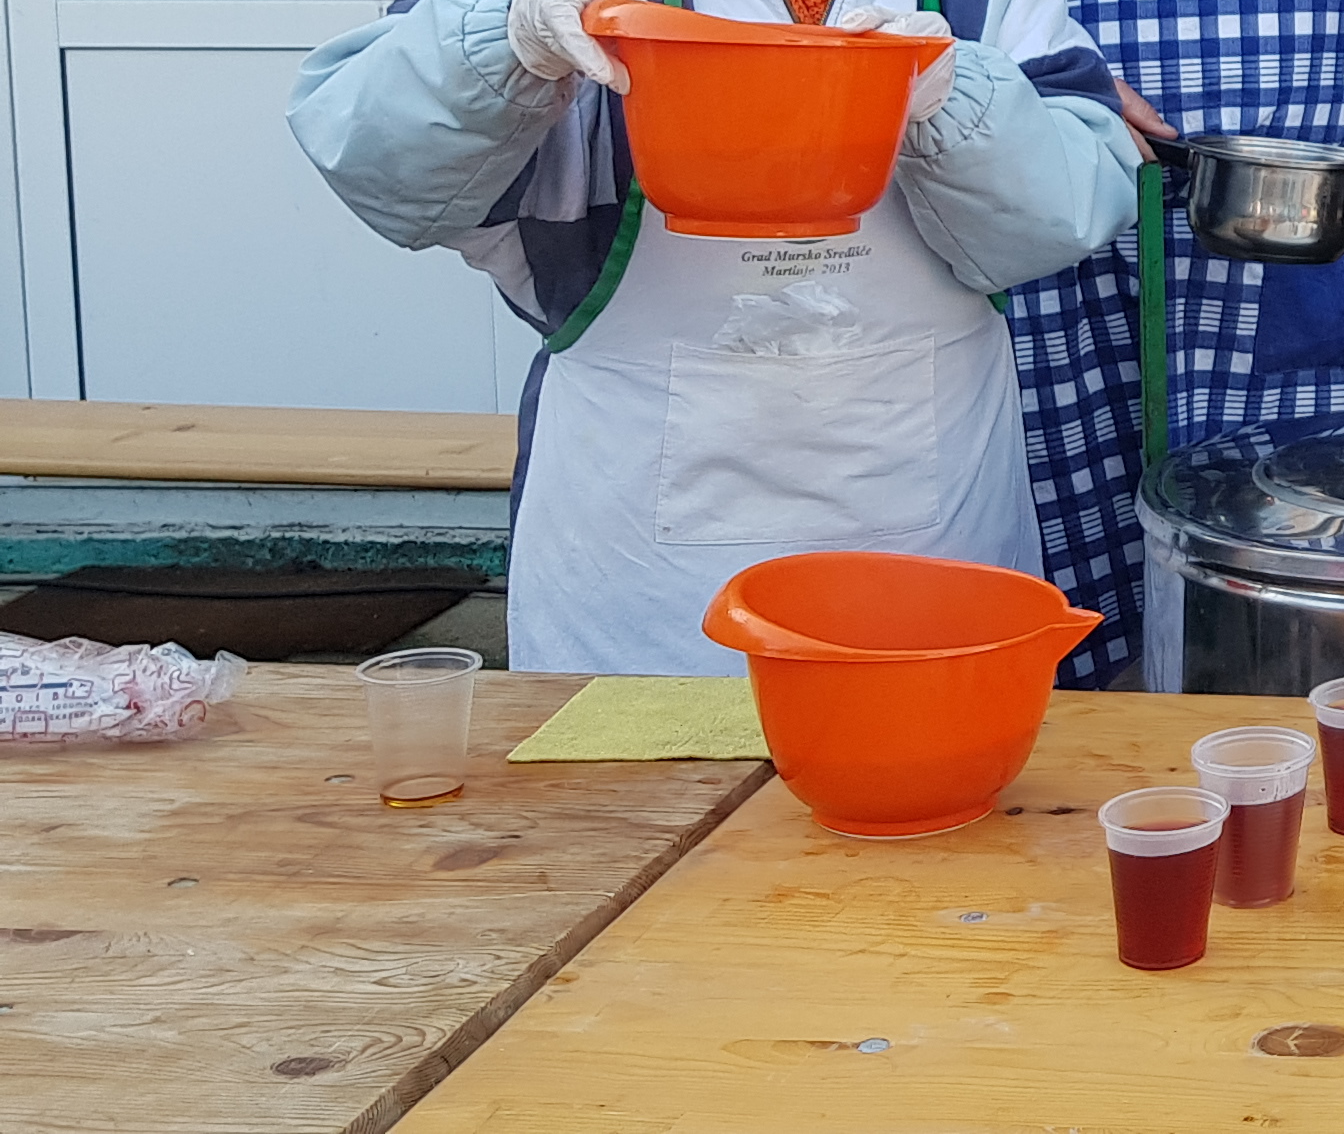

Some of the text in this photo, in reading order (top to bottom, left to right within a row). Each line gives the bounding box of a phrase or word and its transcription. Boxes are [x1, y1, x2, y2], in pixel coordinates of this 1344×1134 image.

[741, 250, 772, 262] Grad
[774, 249, 821, 262] Mursko
[821, 262, 851, 274] 2013
